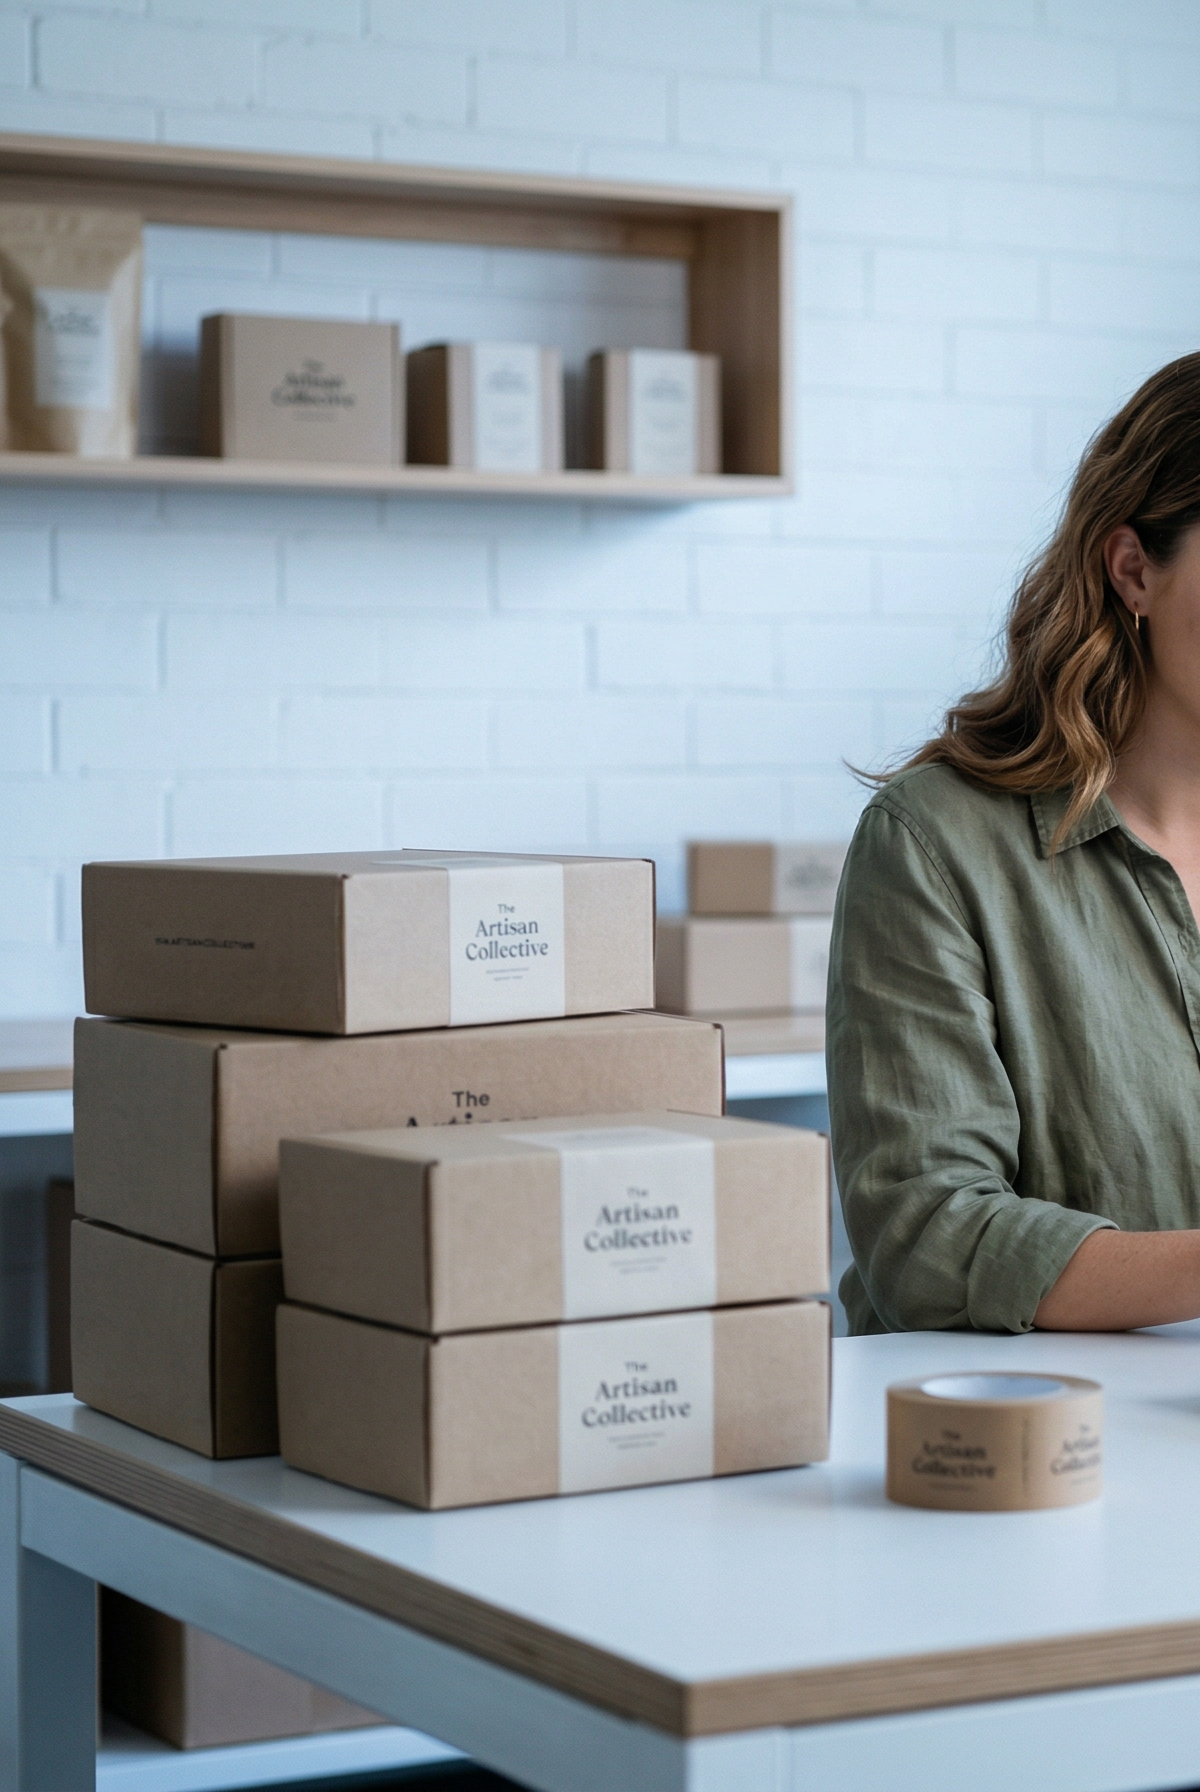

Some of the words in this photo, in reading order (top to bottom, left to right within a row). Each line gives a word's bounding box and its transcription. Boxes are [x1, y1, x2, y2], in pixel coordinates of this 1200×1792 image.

[497, 903, 515, 914] The
[475, 917, 539, 938] Artisan
[465, 938, 549, 961] Collective
[452, 1090, 491, 1108] The
[595, 1202, 680, 1227] Artisan
[583, 1224, 693, 1253] Collective
[594, 1376, 679, 1402] Artisan
[581, 1399, 692, 1429] Collective
